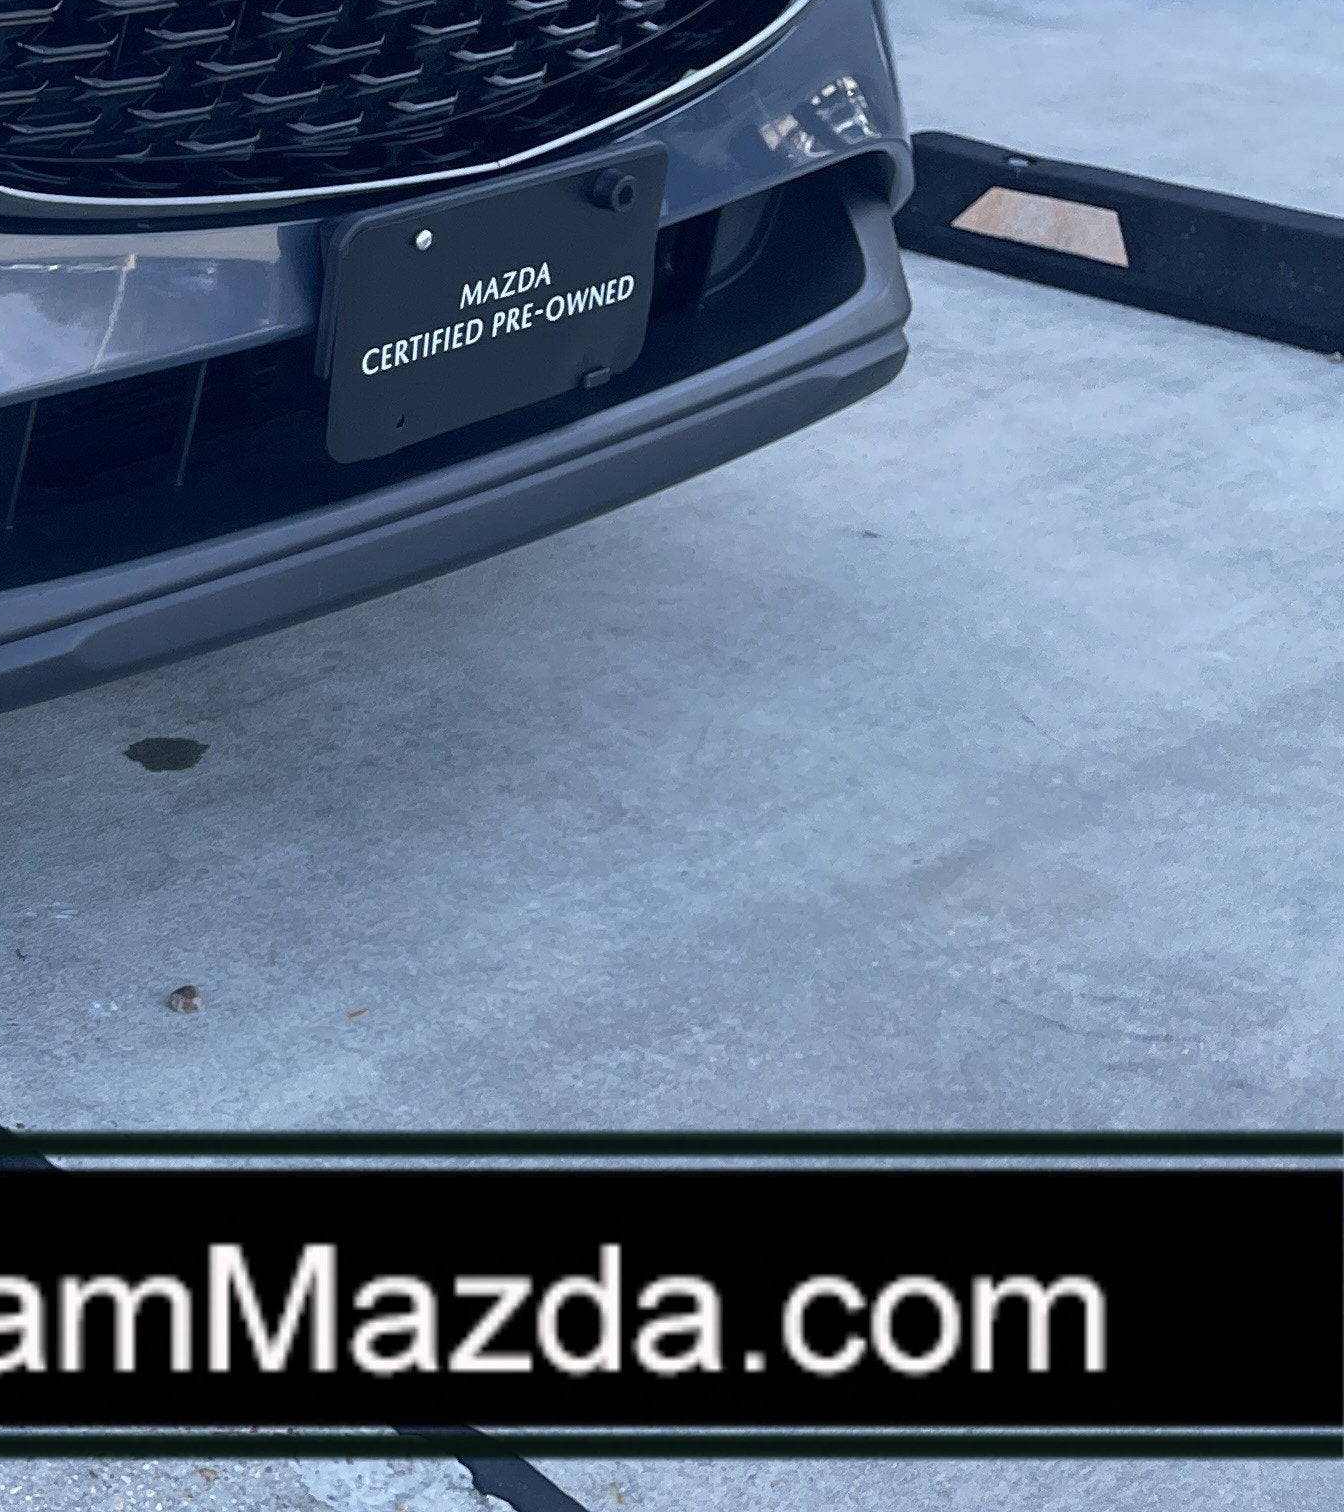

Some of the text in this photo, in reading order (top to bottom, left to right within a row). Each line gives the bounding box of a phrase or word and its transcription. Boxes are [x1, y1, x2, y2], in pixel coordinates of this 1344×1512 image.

[458, 261, 552, 311] MAZDA
[361, 274, 635, 376] CERTIFIED PRE-OWNED
